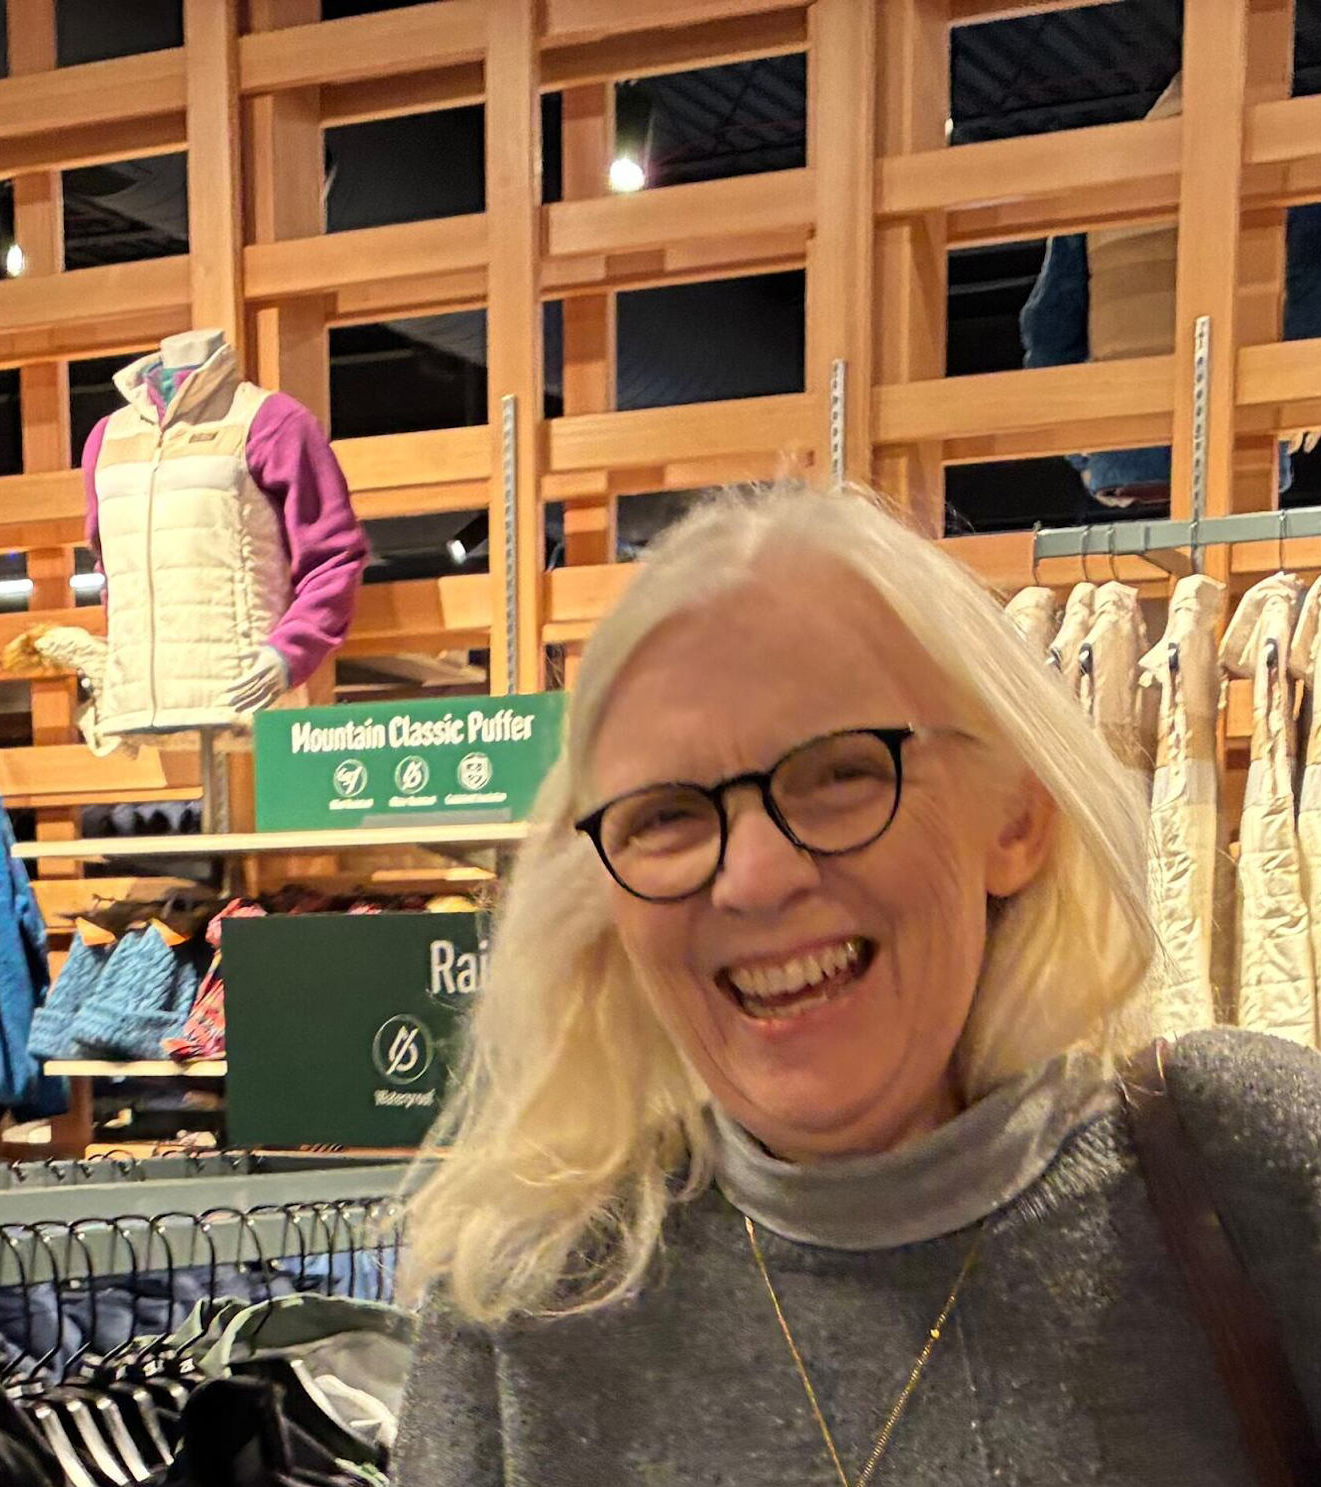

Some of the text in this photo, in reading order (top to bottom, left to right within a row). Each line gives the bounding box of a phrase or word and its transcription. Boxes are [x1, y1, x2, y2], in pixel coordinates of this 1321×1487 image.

[291, 709, 535, 754] Mountain Classic Puffer
